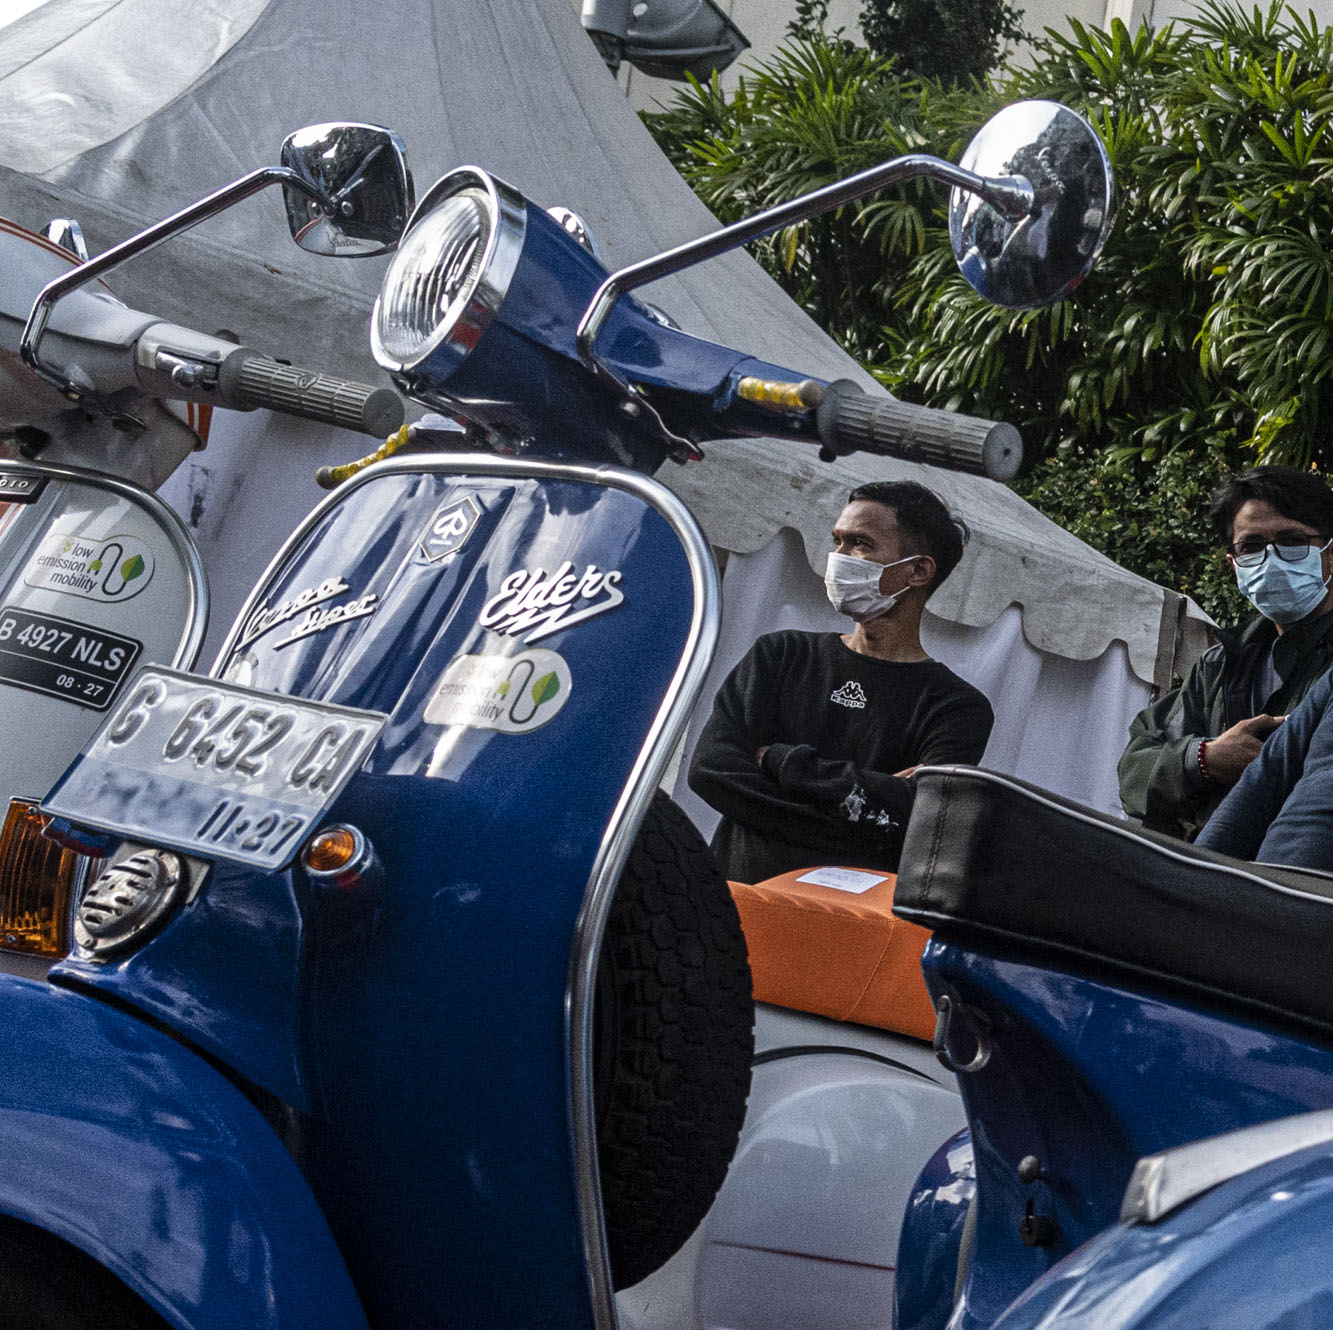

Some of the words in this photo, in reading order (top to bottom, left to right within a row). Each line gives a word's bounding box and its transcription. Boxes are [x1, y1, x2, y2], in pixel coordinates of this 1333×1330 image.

[37, 553, 86, 573] emission
[72, 543, 94, 559] low
[50, 571, 98, 593] mobility
[478, 561, 625, 646] Elders
[0, 618, 17, 641] B
[16, 623, 73, 654] 4927
[70, 636, 126, 671] NLS
[163, 697, 297, 778] 6452
